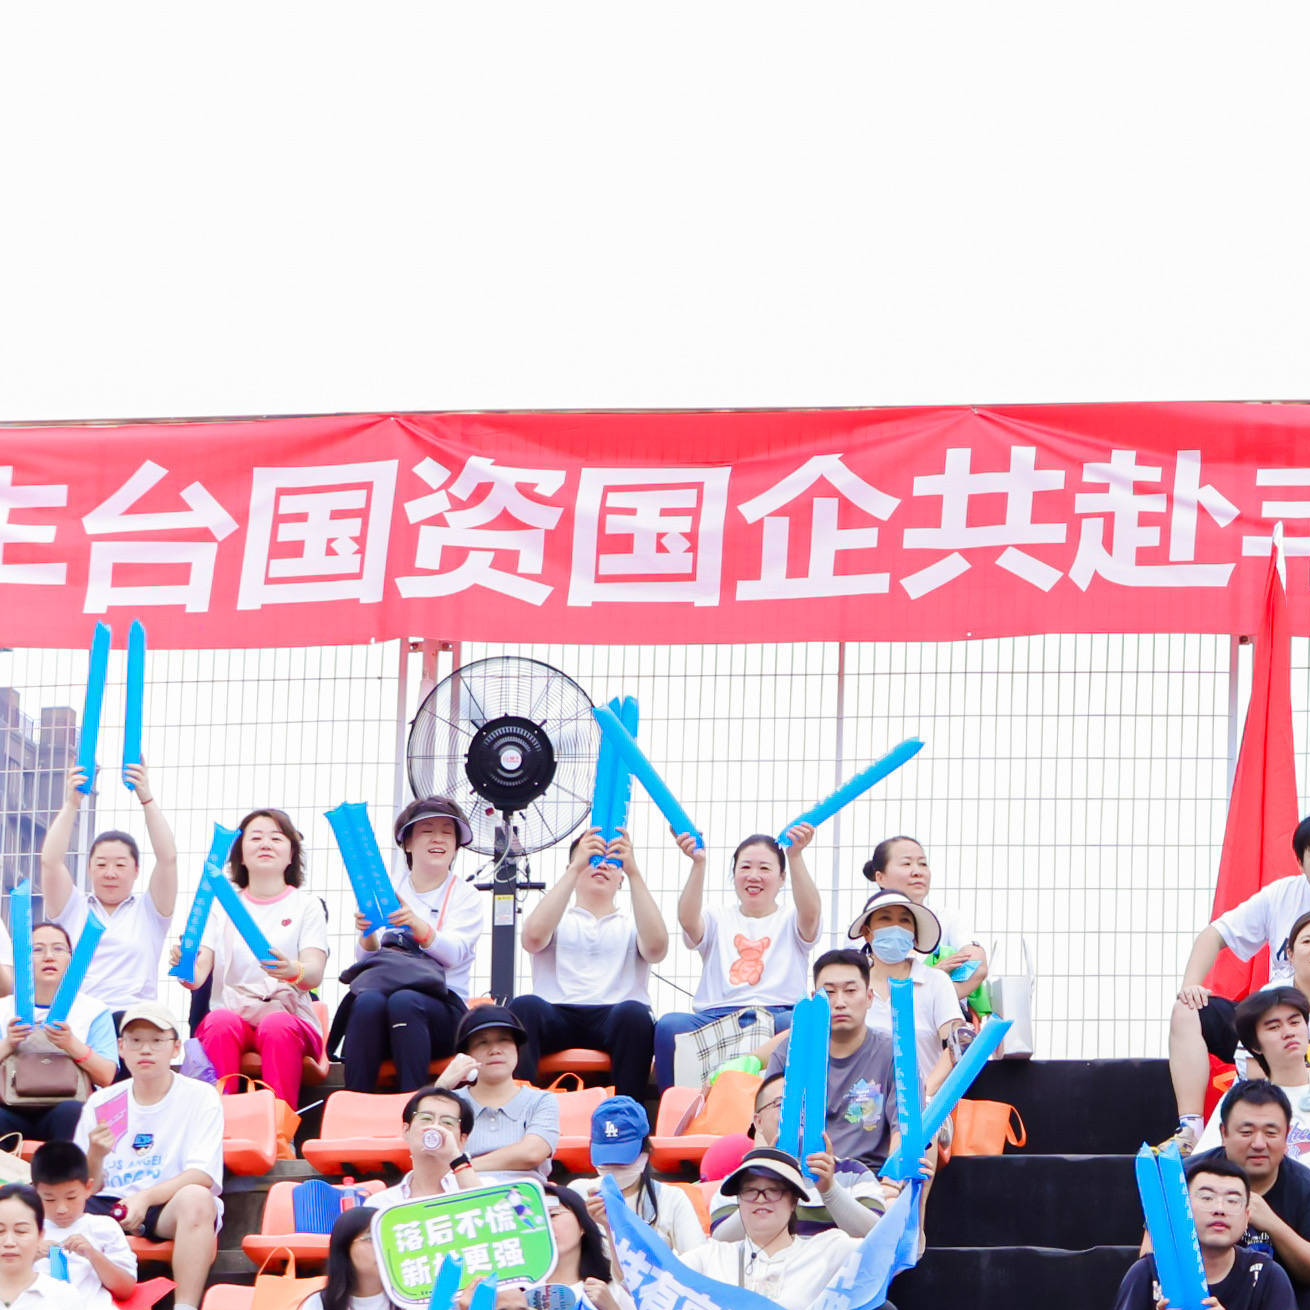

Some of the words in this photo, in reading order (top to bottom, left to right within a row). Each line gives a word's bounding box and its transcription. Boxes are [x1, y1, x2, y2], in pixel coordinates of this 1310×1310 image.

[605, 1120, 618, 1138] LA
[392, 1203, 517, 1254] 落后不慌
